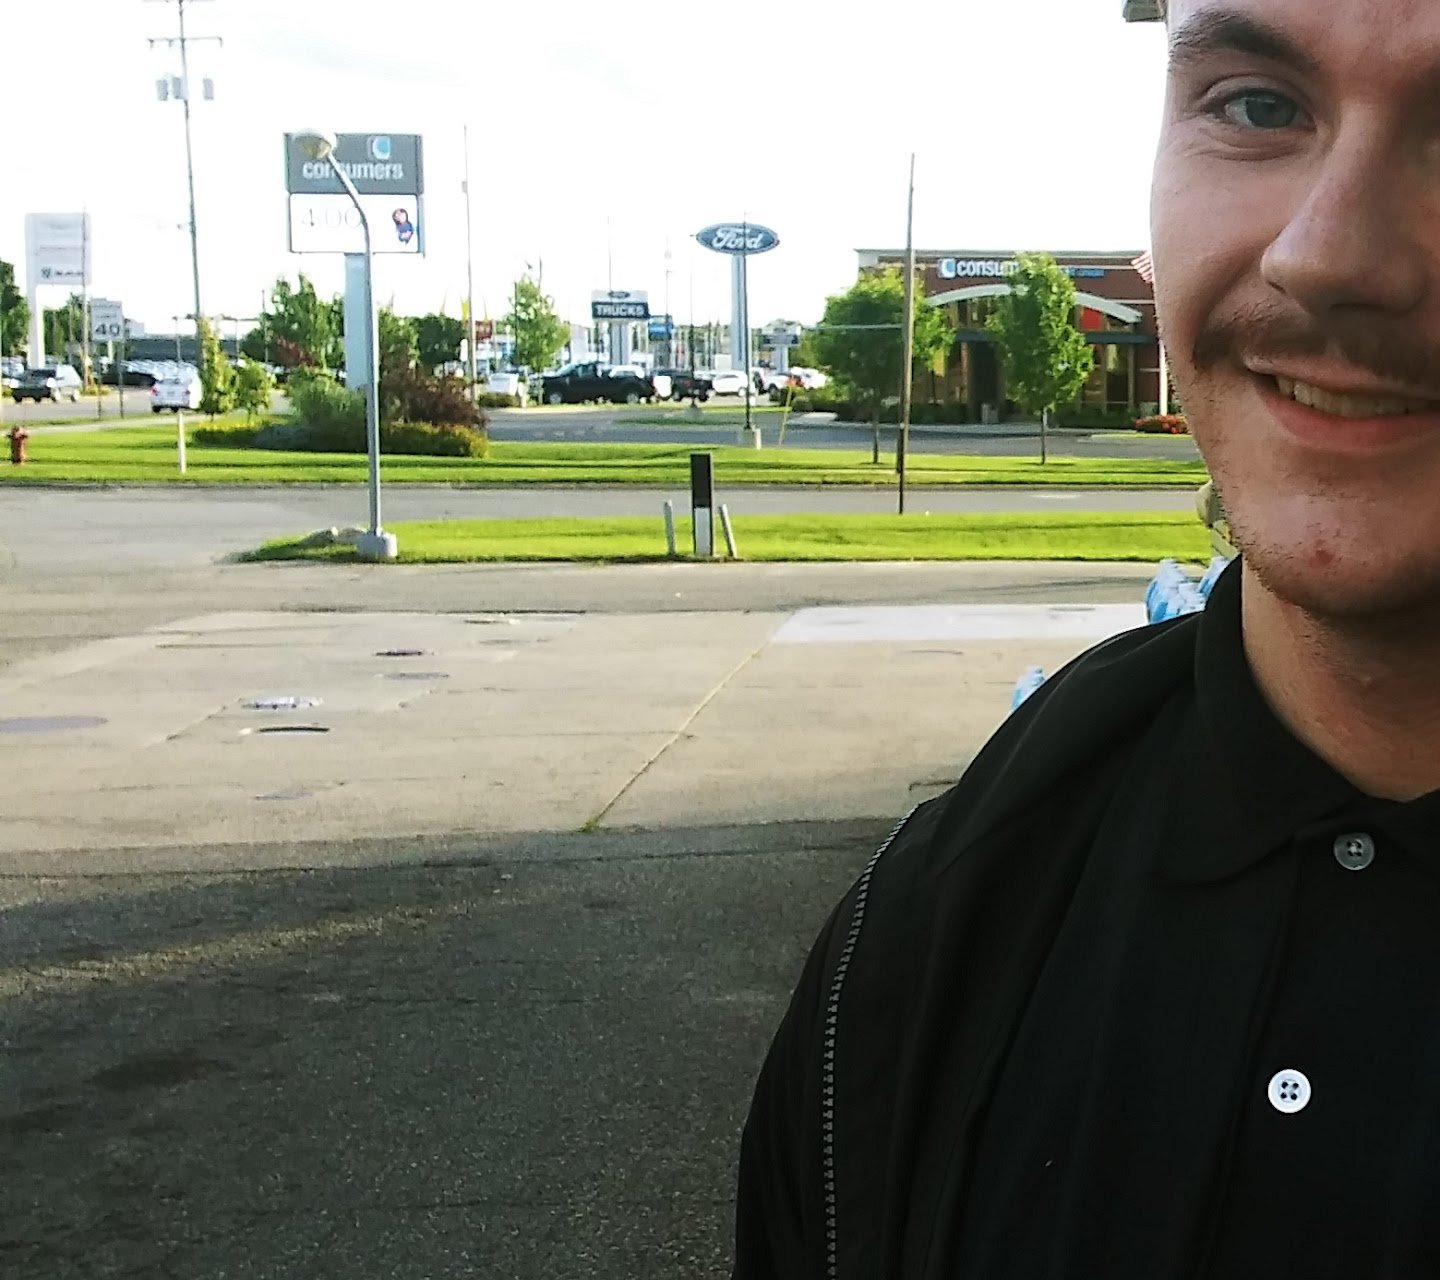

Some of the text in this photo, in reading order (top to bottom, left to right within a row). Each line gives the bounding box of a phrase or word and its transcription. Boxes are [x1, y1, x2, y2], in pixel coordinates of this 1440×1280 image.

[302, 161, 404, 180] conumers
[712, 227, 761, 249] Ford
[956, 260, 1020, 277] consum
[595, 304, 645, 317] TRUCKS
[95, 323, 120, 337] 40
